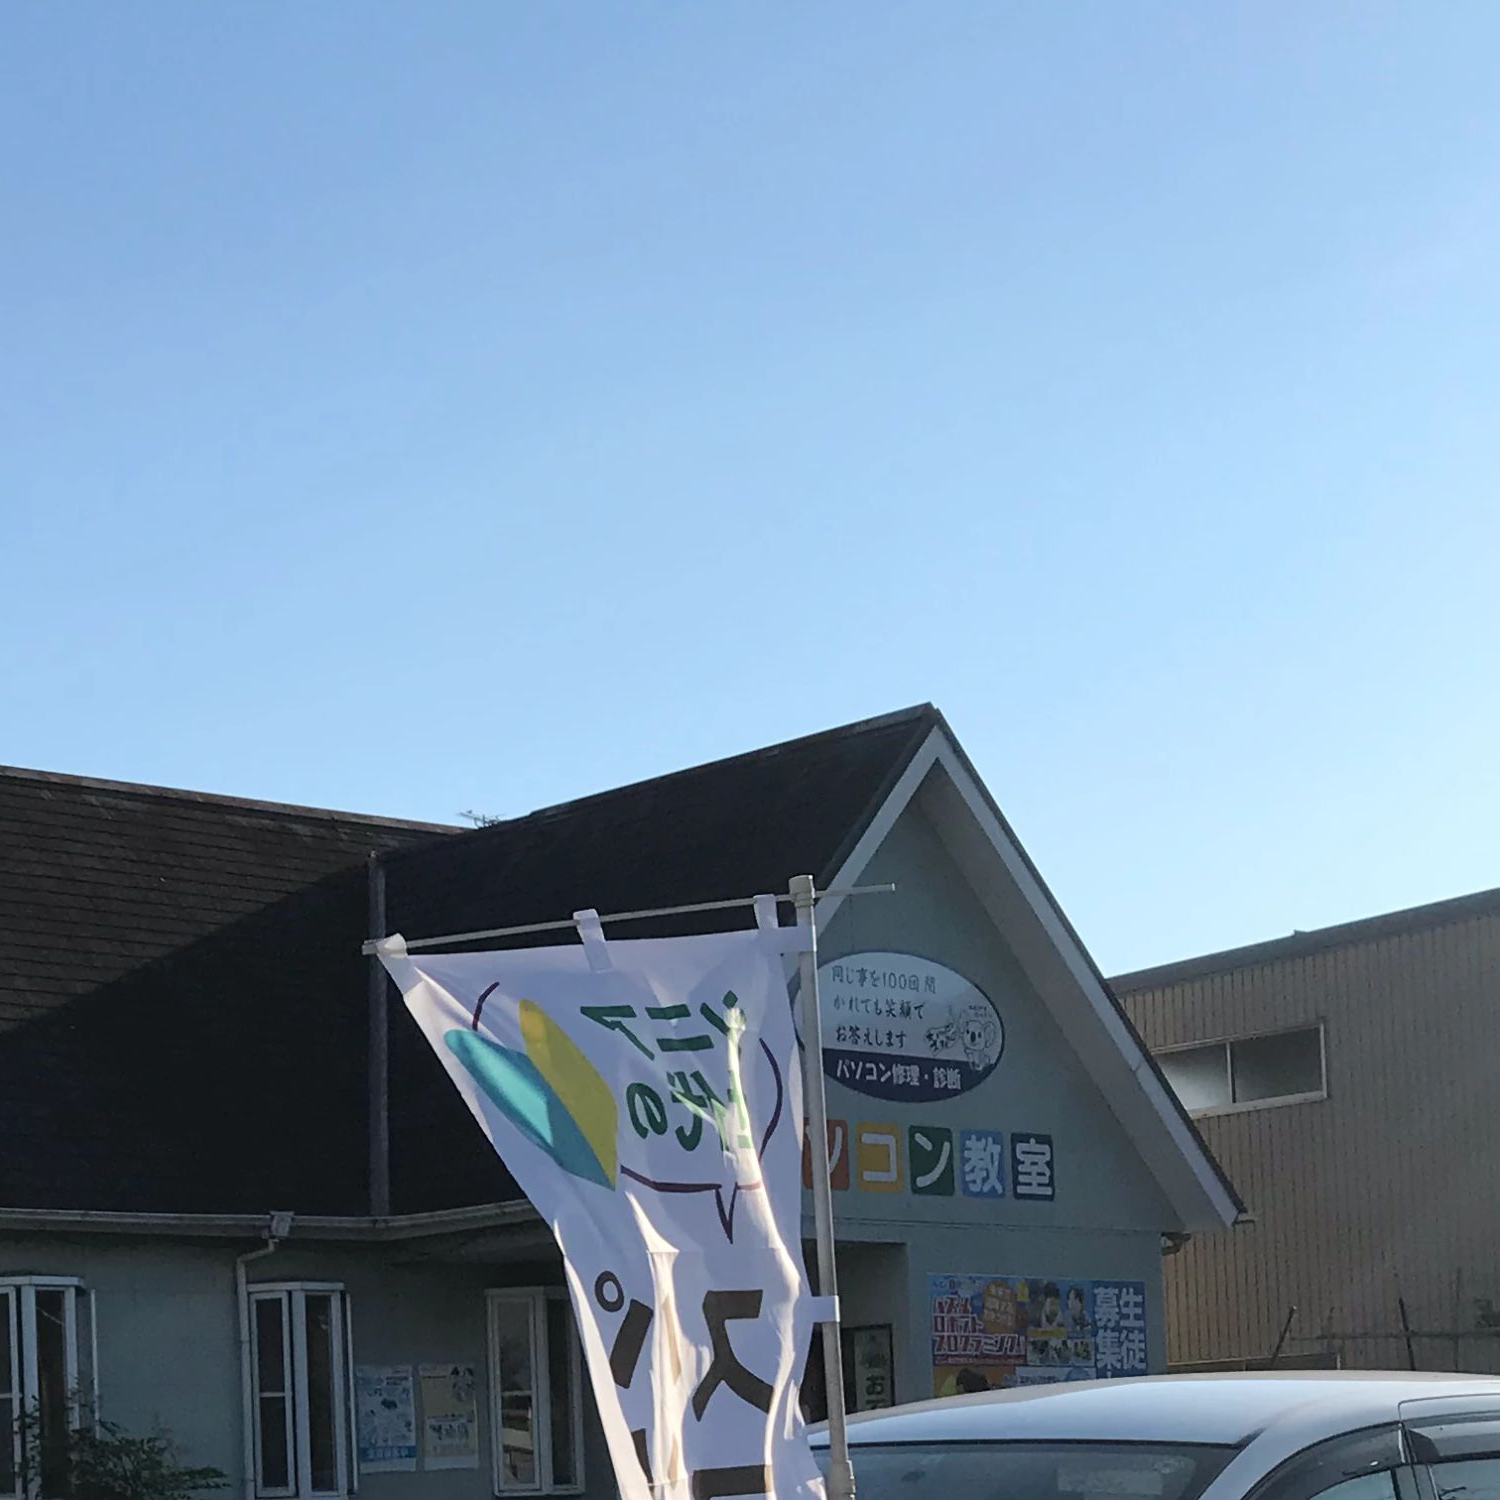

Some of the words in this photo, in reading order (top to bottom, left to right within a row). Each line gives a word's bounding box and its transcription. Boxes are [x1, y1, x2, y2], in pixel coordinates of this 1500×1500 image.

[836, 1026, 907, 1049] お答えします
[836, 1059, 962, 1090] パソコン修理・診断
[1094, 1286, 1120, 1379] 募集
[1121, 1286, 1147, 1370] 生徒
